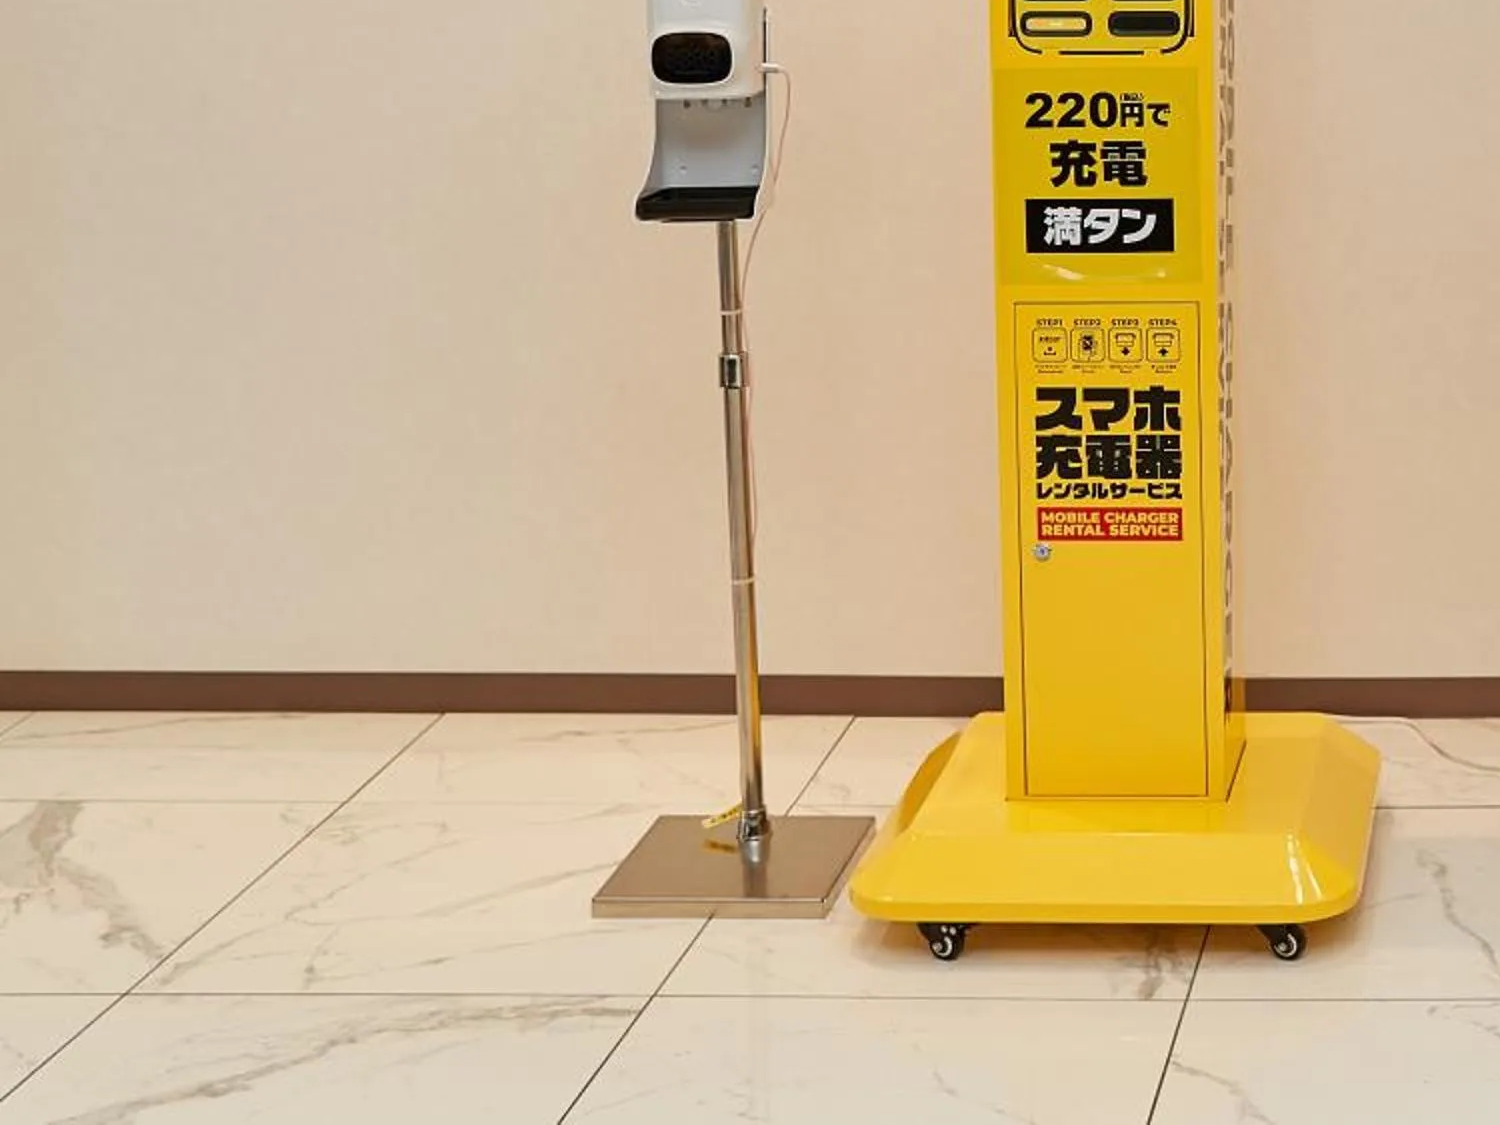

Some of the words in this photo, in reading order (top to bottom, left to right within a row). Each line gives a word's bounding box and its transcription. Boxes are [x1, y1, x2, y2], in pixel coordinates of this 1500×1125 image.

[1049, 139, 1148, 187] 充電
[1043, 206, 1157, 246] 満タン
[1035, 386, 1182, 431] スマホ
[1035, 435, 1182, 479] 充電器
[1036, 482, 1183, 500] レンタルサービス
[1041, 511, 1100, 524] MOBILE
[1104, 511, 1179, 523] CHARGER
[1041, 524, 1105, 537] RENTAL
[1109, 524, 1179, 537] SERVICE
